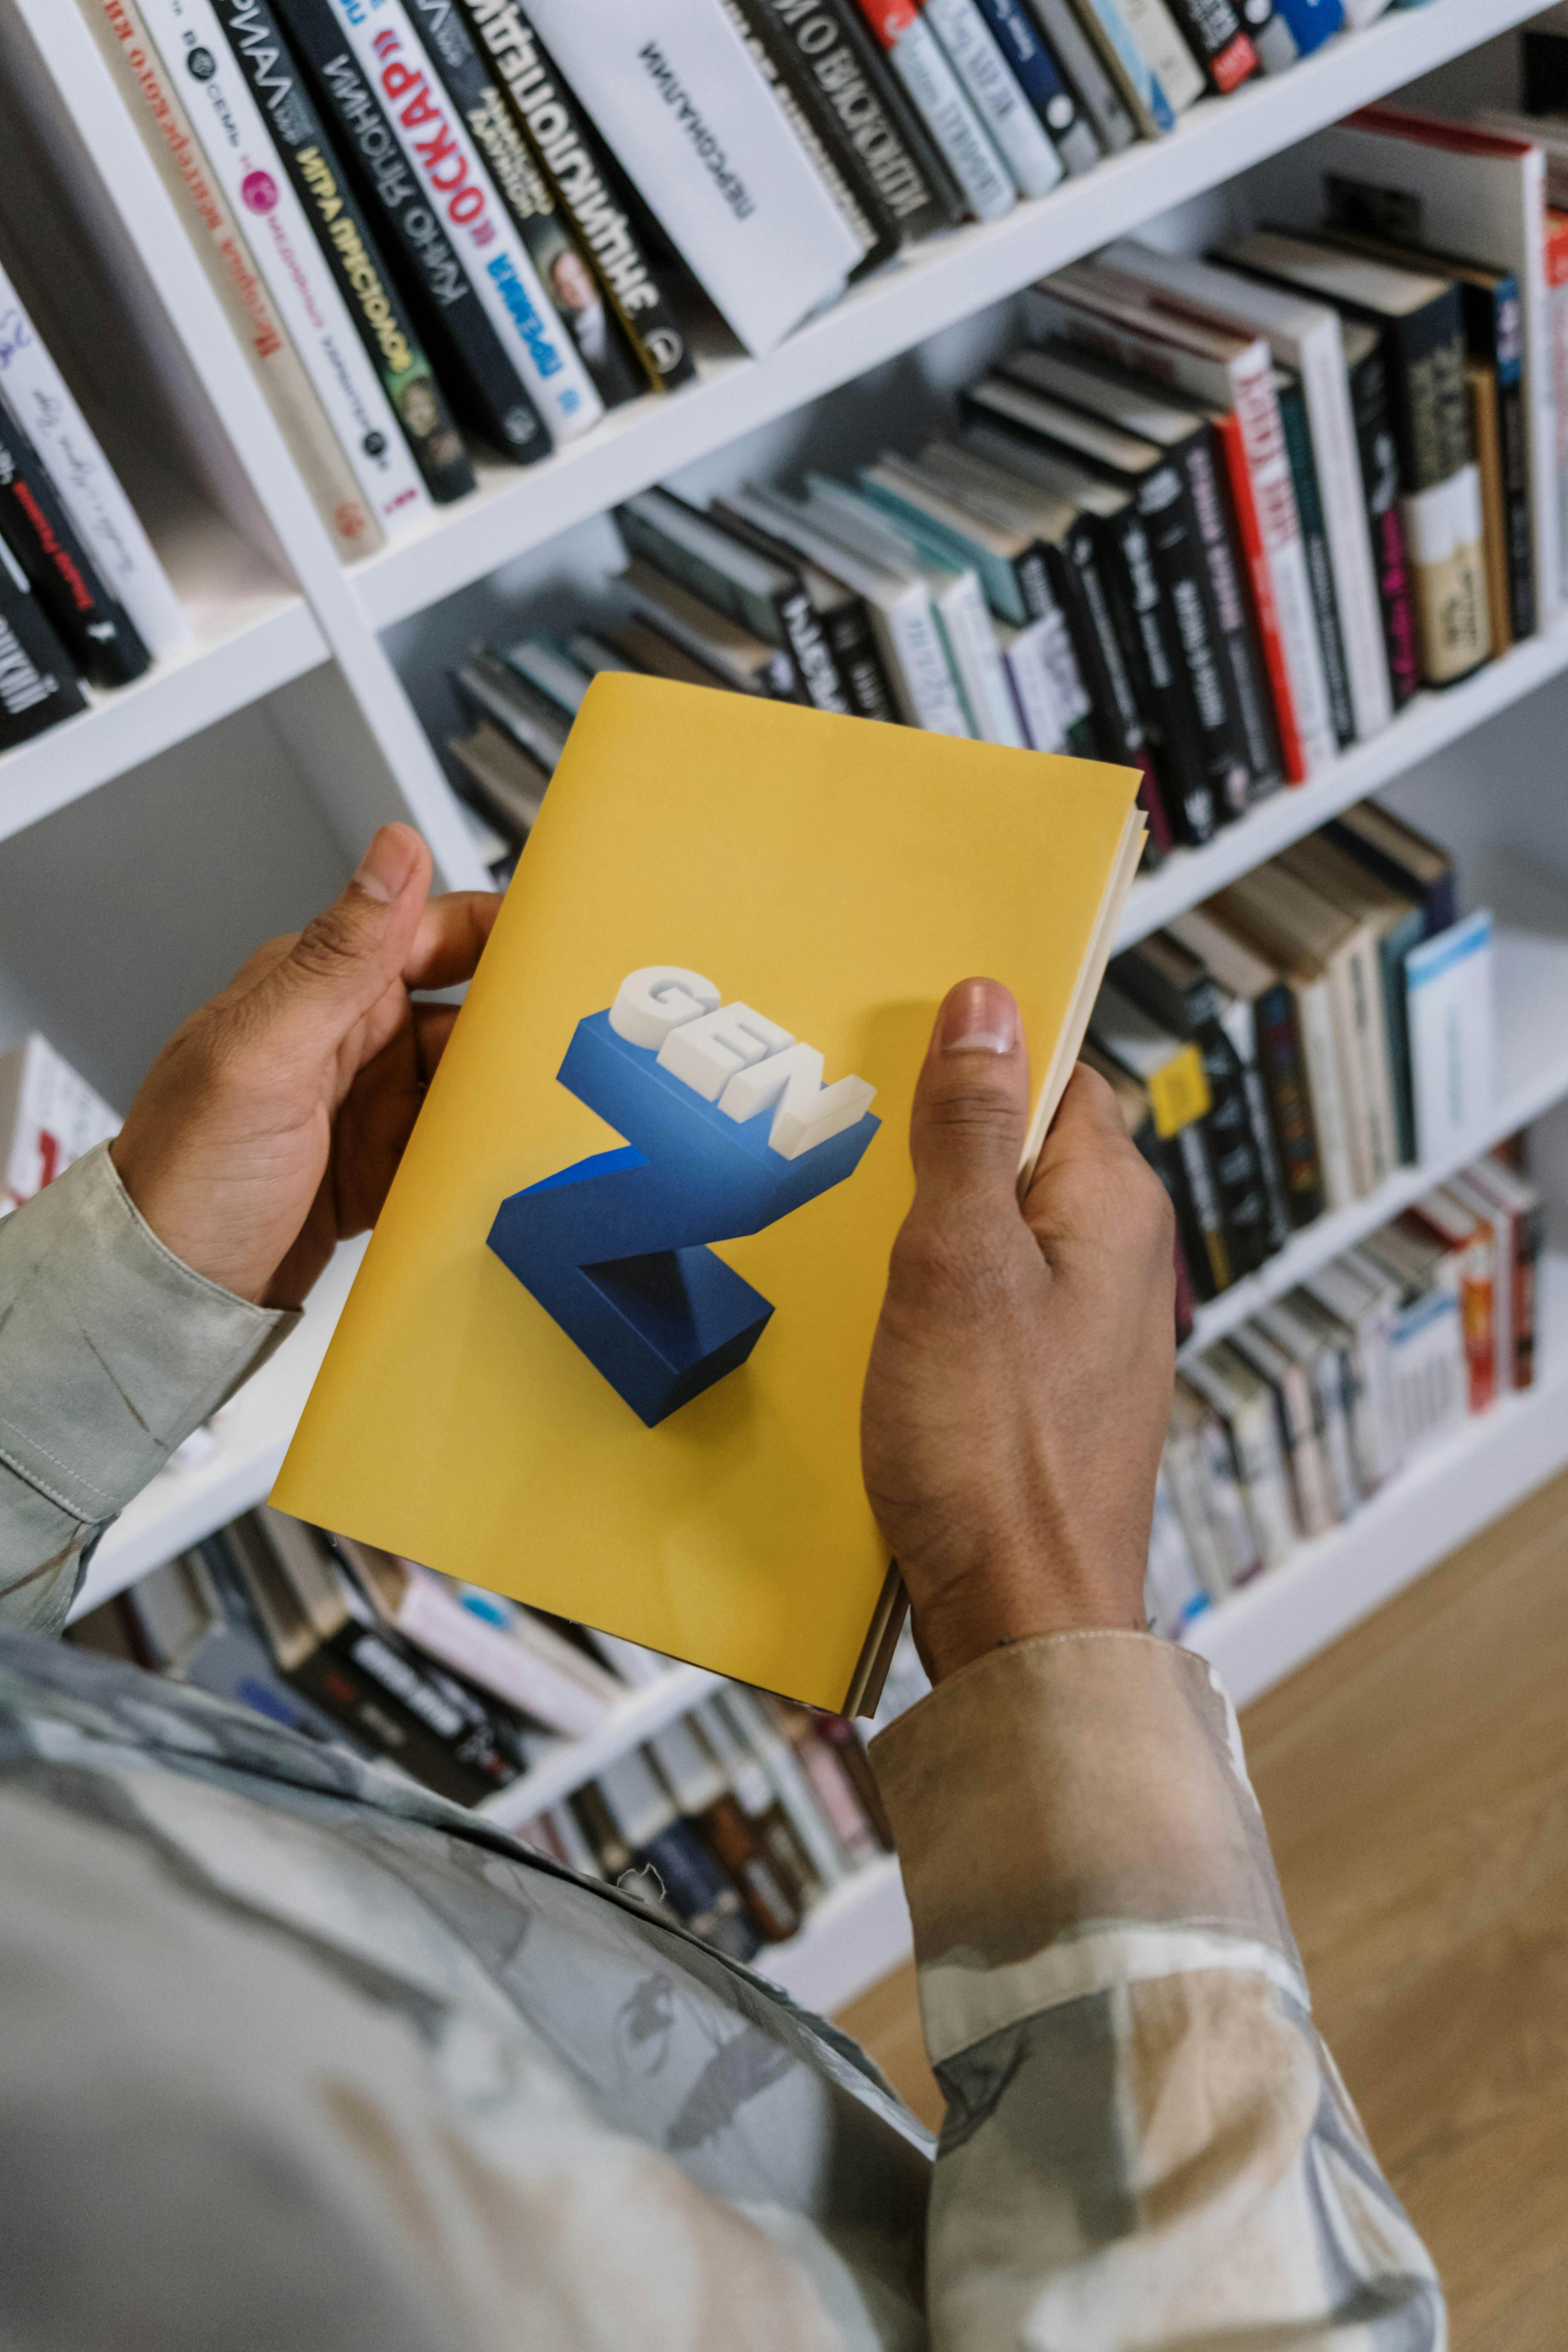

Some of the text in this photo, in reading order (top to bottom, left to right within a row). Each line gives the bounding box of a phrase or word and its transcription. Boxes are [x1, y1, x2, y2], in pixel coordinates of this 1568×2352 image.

[634, 38, 759, 222] ПЕРСОНАЛИИ
[796, 15, 838, 54] О
[124, 43, 230, 233] венгерского
[320, 51, 472, 307] КИНО ЯПОНИИ
[288, 145, 348, 225] ИГРА
[324, 216, 418, 376] ПРЕСТОЛОВ
[483, 251, 565, 380] ПРЕМИЯ
[608, 964, 878, 1162] GEN
[485, 1007, 883, 1429] Z
